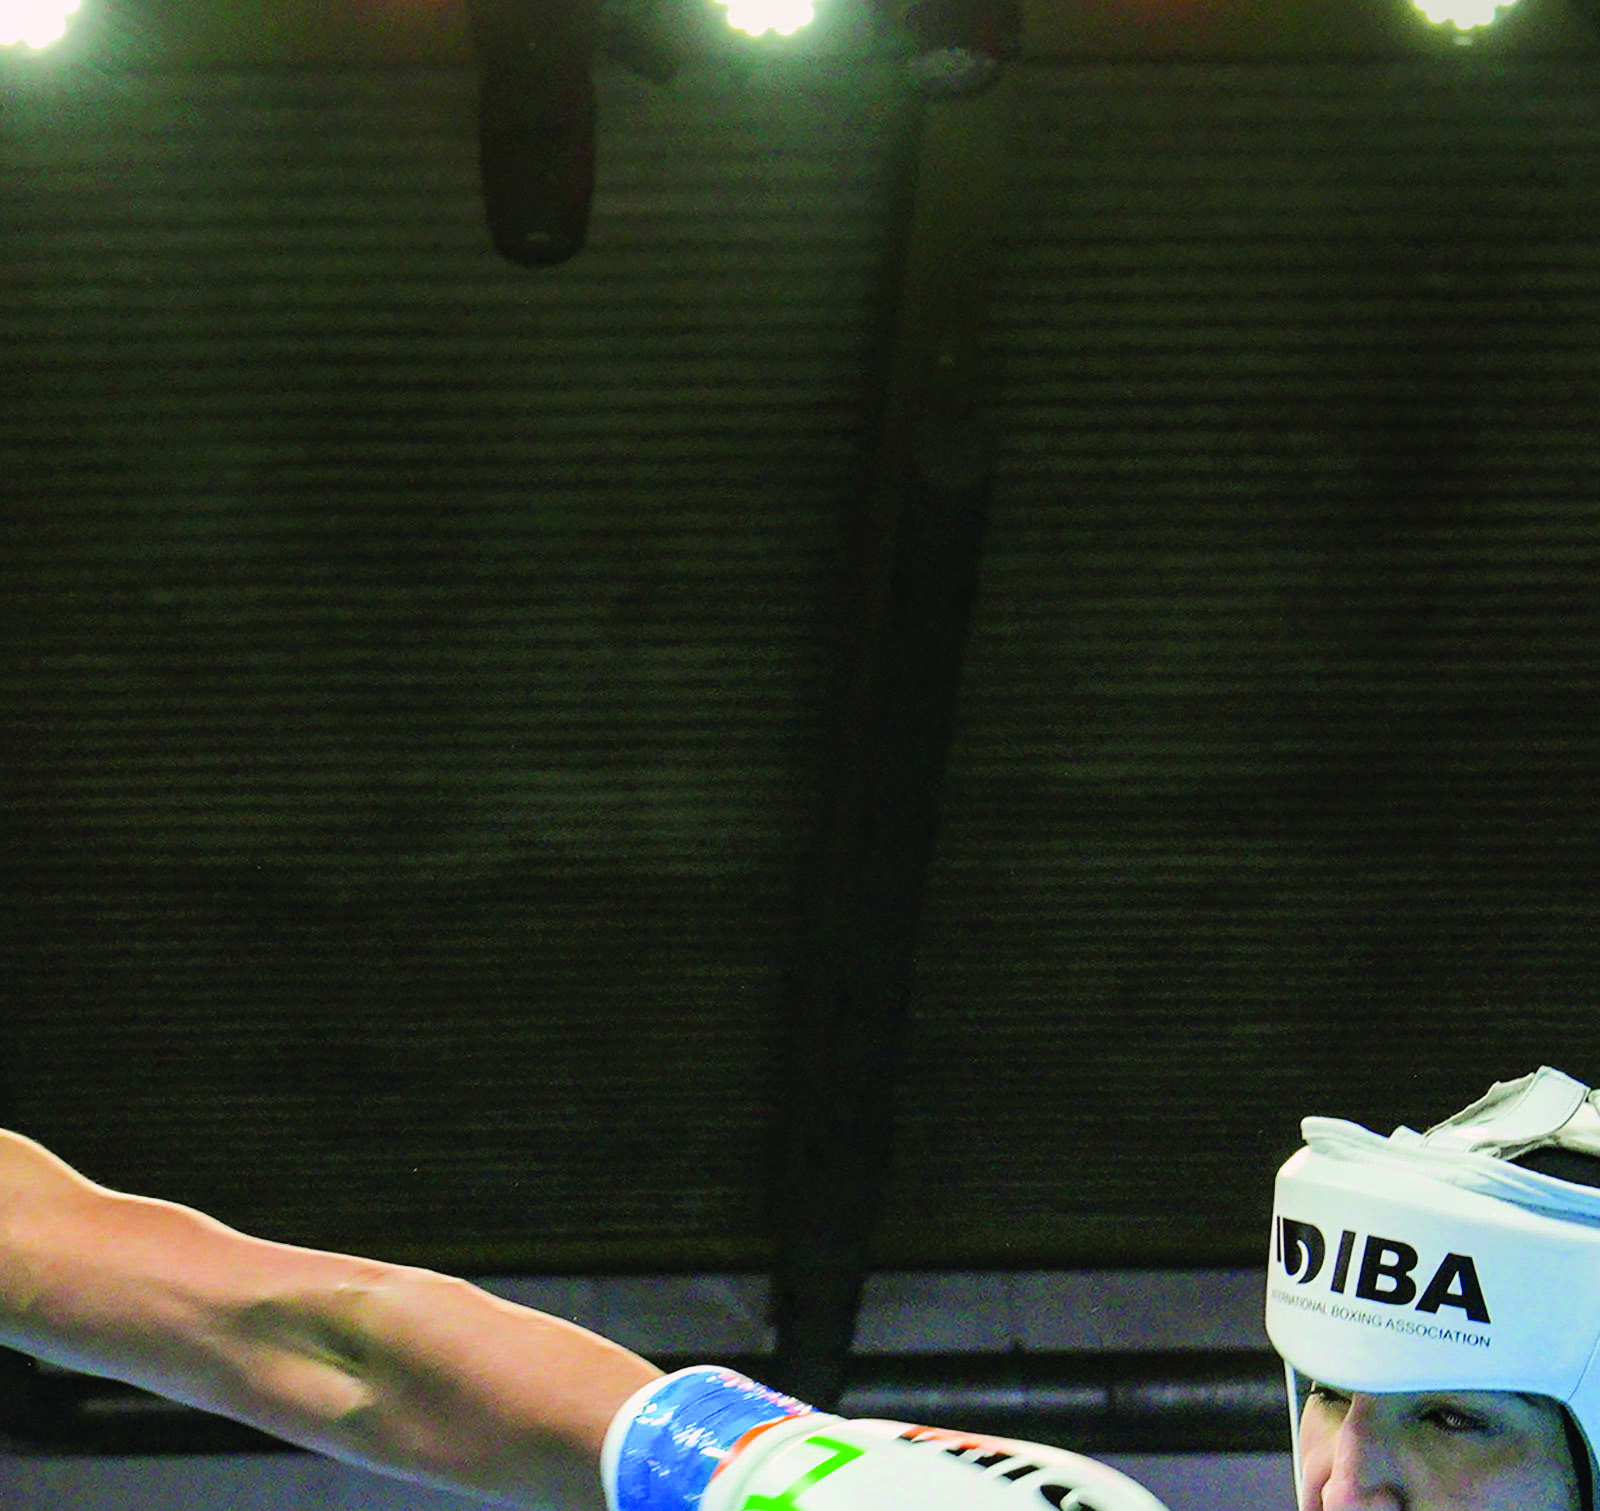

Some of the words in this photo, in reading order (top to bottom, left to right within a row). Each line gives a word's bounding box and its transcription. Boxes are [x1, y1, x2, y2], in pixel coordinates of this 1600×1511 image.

[1330, 1229, 1492, 1325] IBA
[1331, 1304, 1383, 1328] BOXING
[1386, 1318, 1492, 1348] ASSOCIATION
